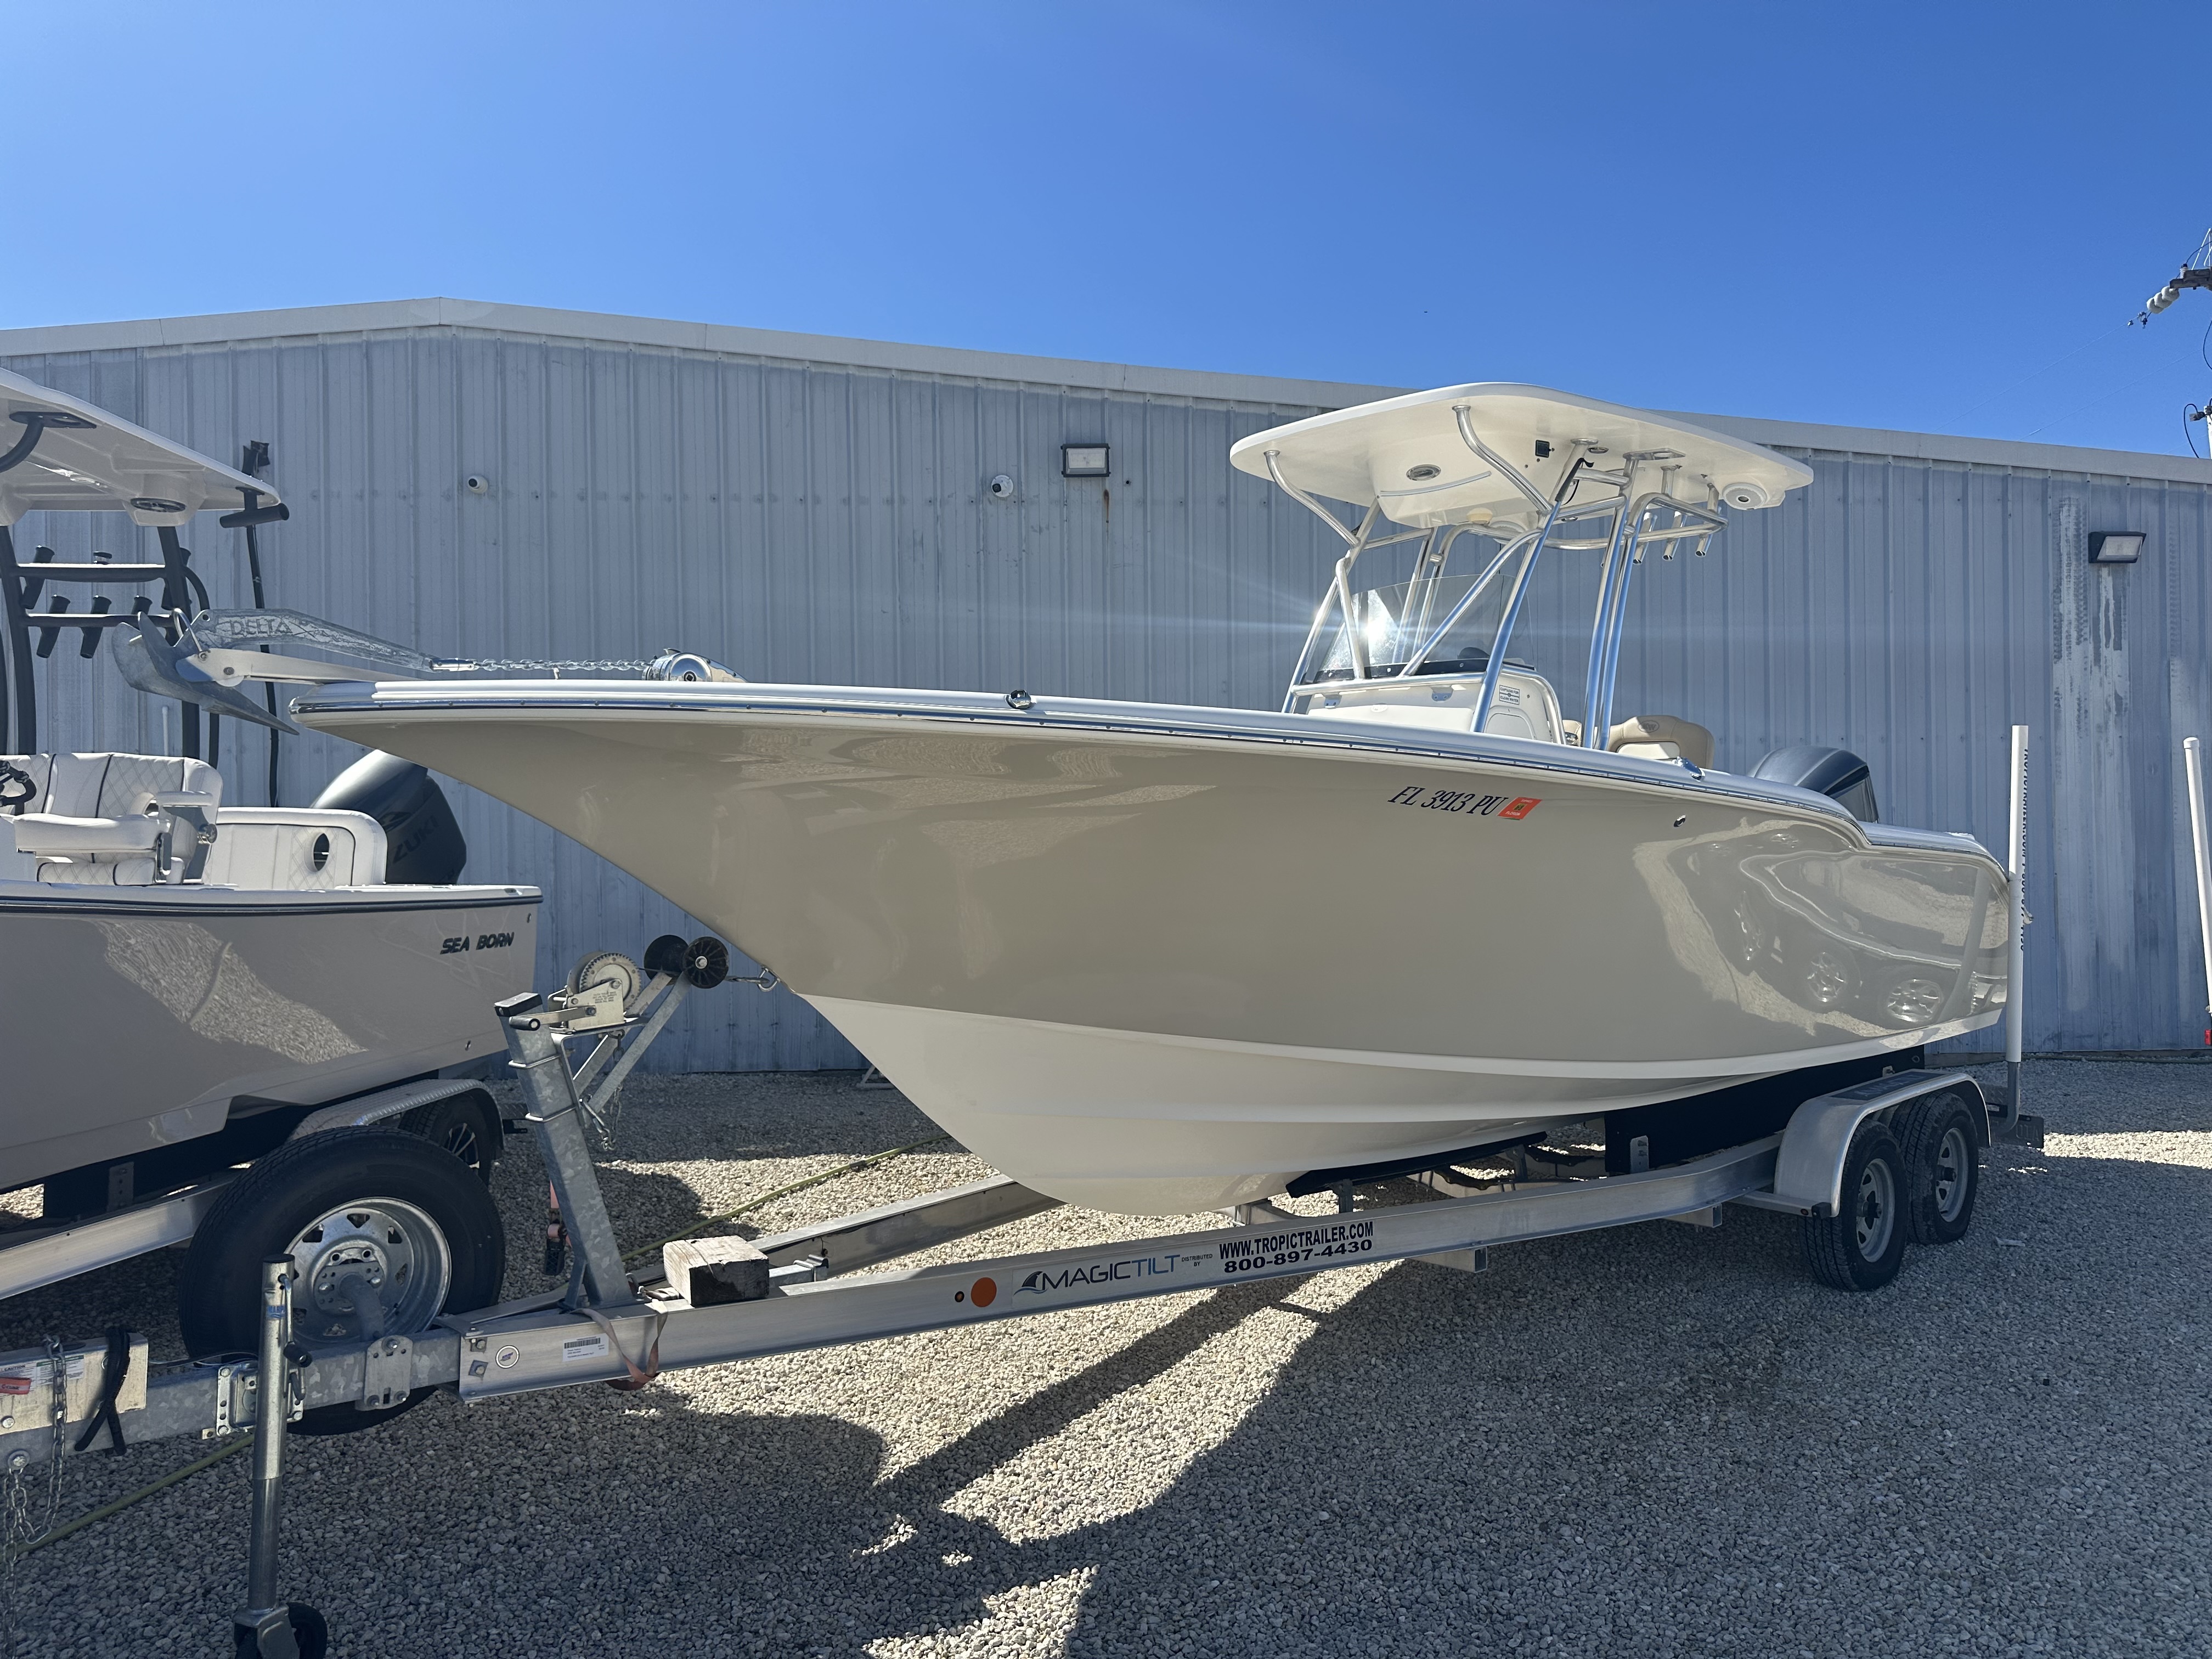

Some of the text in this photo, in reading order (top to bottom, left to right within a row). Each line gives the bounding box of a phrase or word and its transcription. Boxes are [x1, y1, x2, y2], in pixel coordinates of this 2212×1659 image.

[230, 616, 293, 636] DELTA
[1387, 786, 1509, 816] FL 3913 PU
[440, 932, 515, 955] SEA BORN
[1219, 1221, 1374, 1260] WWW.TROPICTRAILER.COM
[1181, 1253, 1213, 1262] DISTRIBUTED
[1224, 1239, 1372, 1273] 800-897-4430
